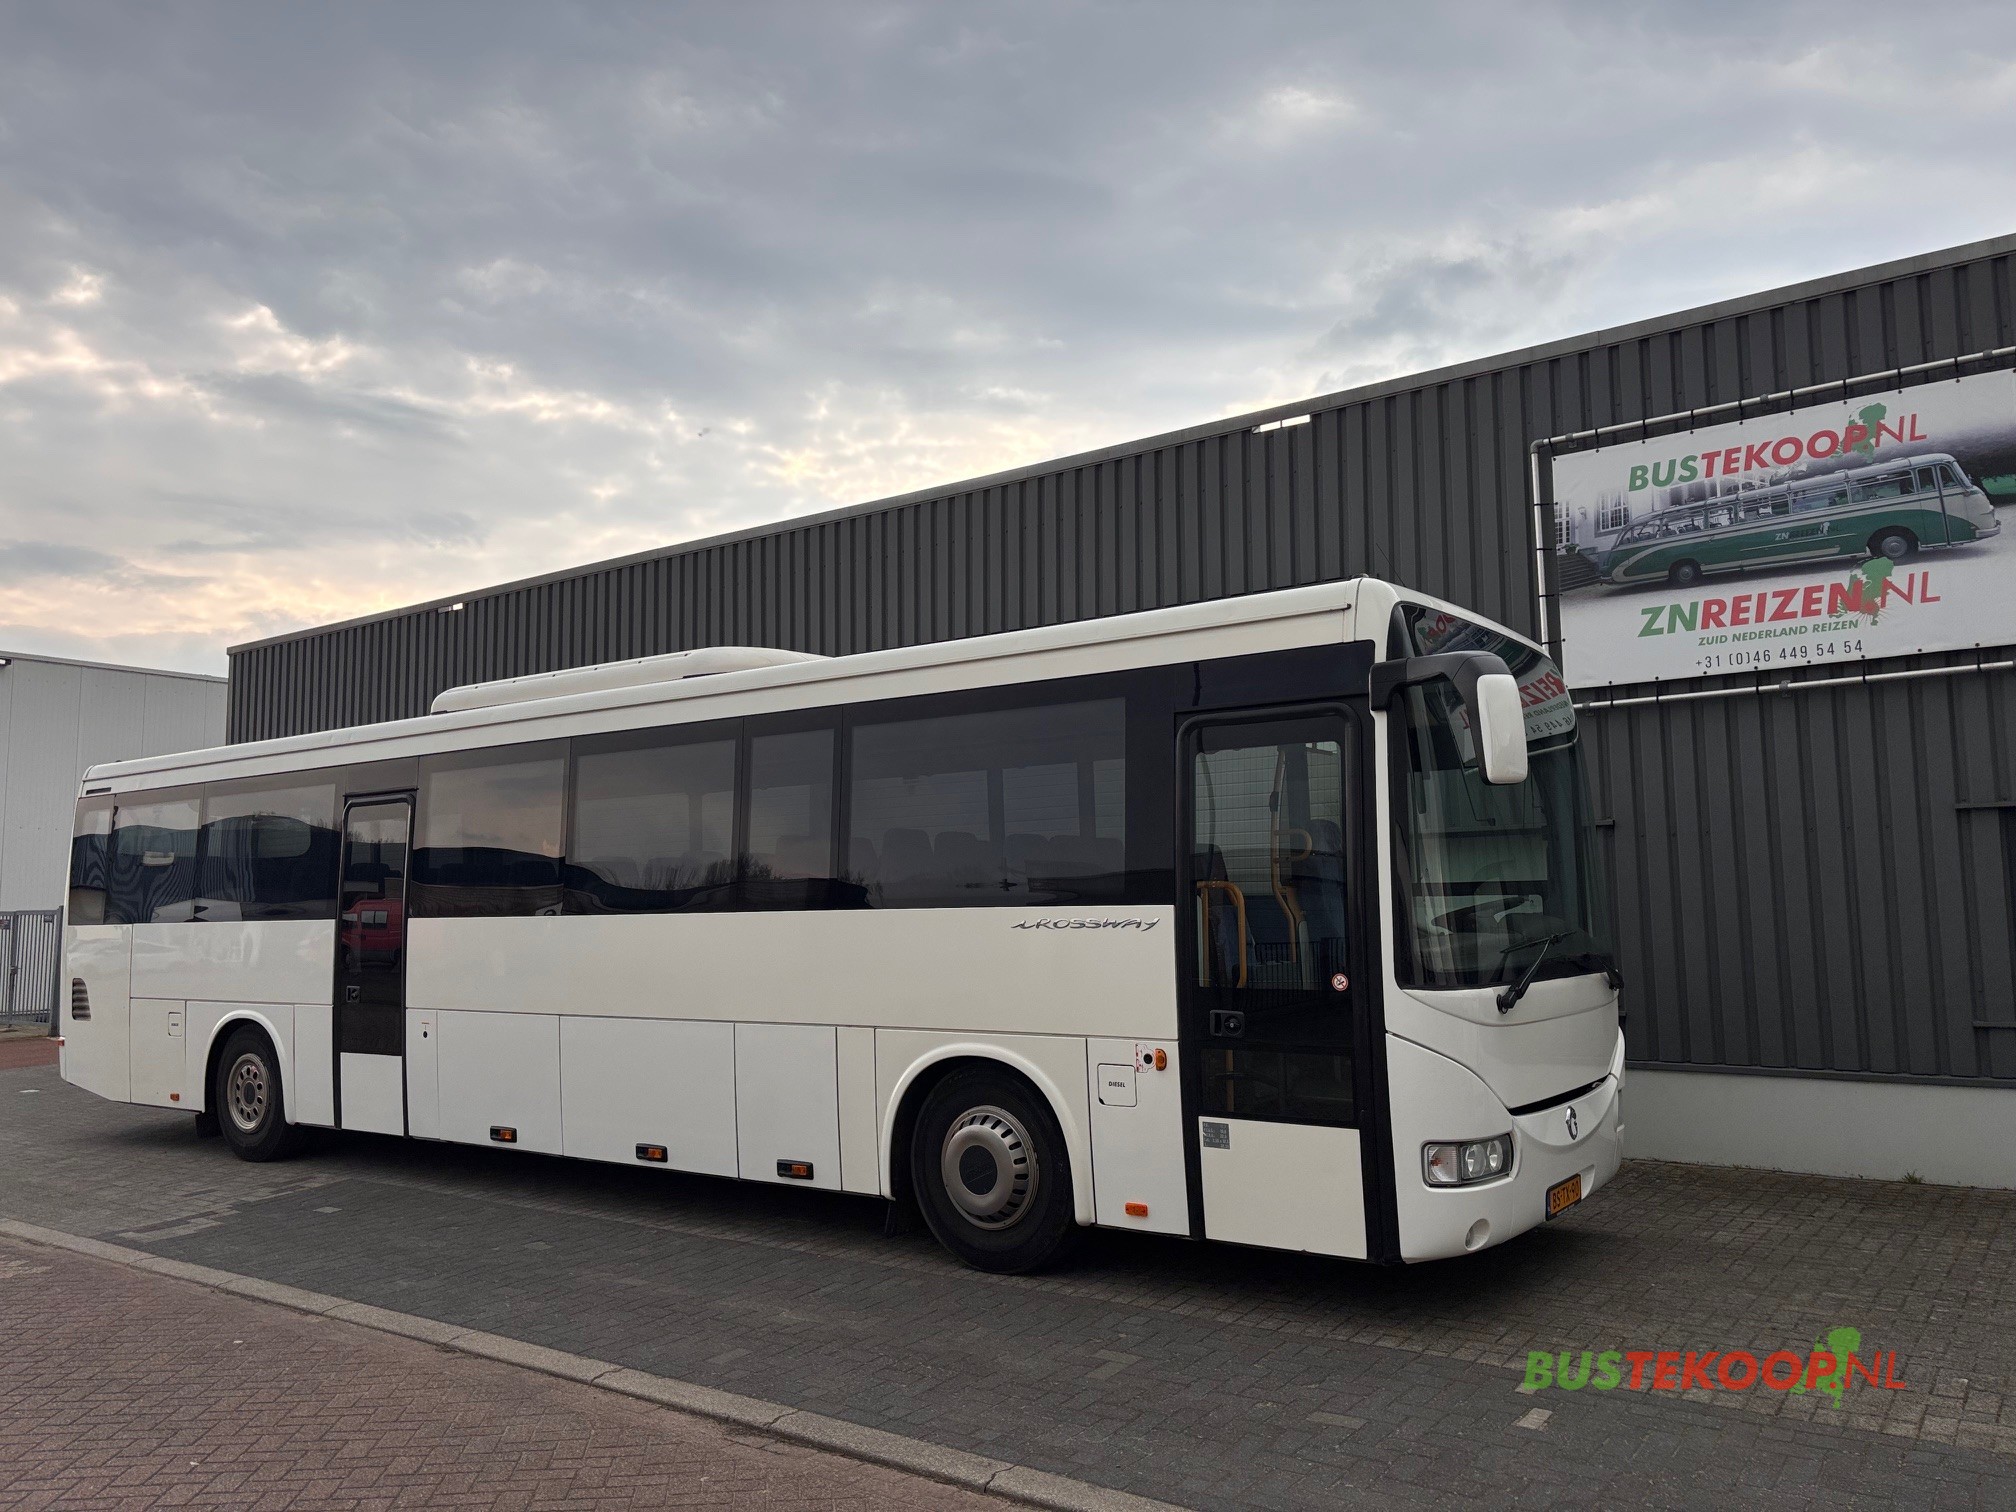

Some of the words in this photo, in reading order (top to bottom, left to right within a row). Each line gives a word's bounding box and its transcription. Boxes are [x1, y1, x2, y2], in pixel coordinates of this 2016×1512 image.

[1628, 413, 1928, 492] BUSTEKOOP.NL
[1637, 571, 1941, 638] ZNREIZEN.NL
[1698, 634, 1728, 646] ZUID
[1732, 625, 1808, 643] NEDERLAND
[1812, 619, 1859, 633] REIZEN
[1695, 655, 1721, 669] +31
[1779, 645, 1808, 661] 449
[1816, 642, 1835, 657] 54
[1844, 639, 1863, 653] 54
[1108, 1080, 1126, 1088] DIESEL
